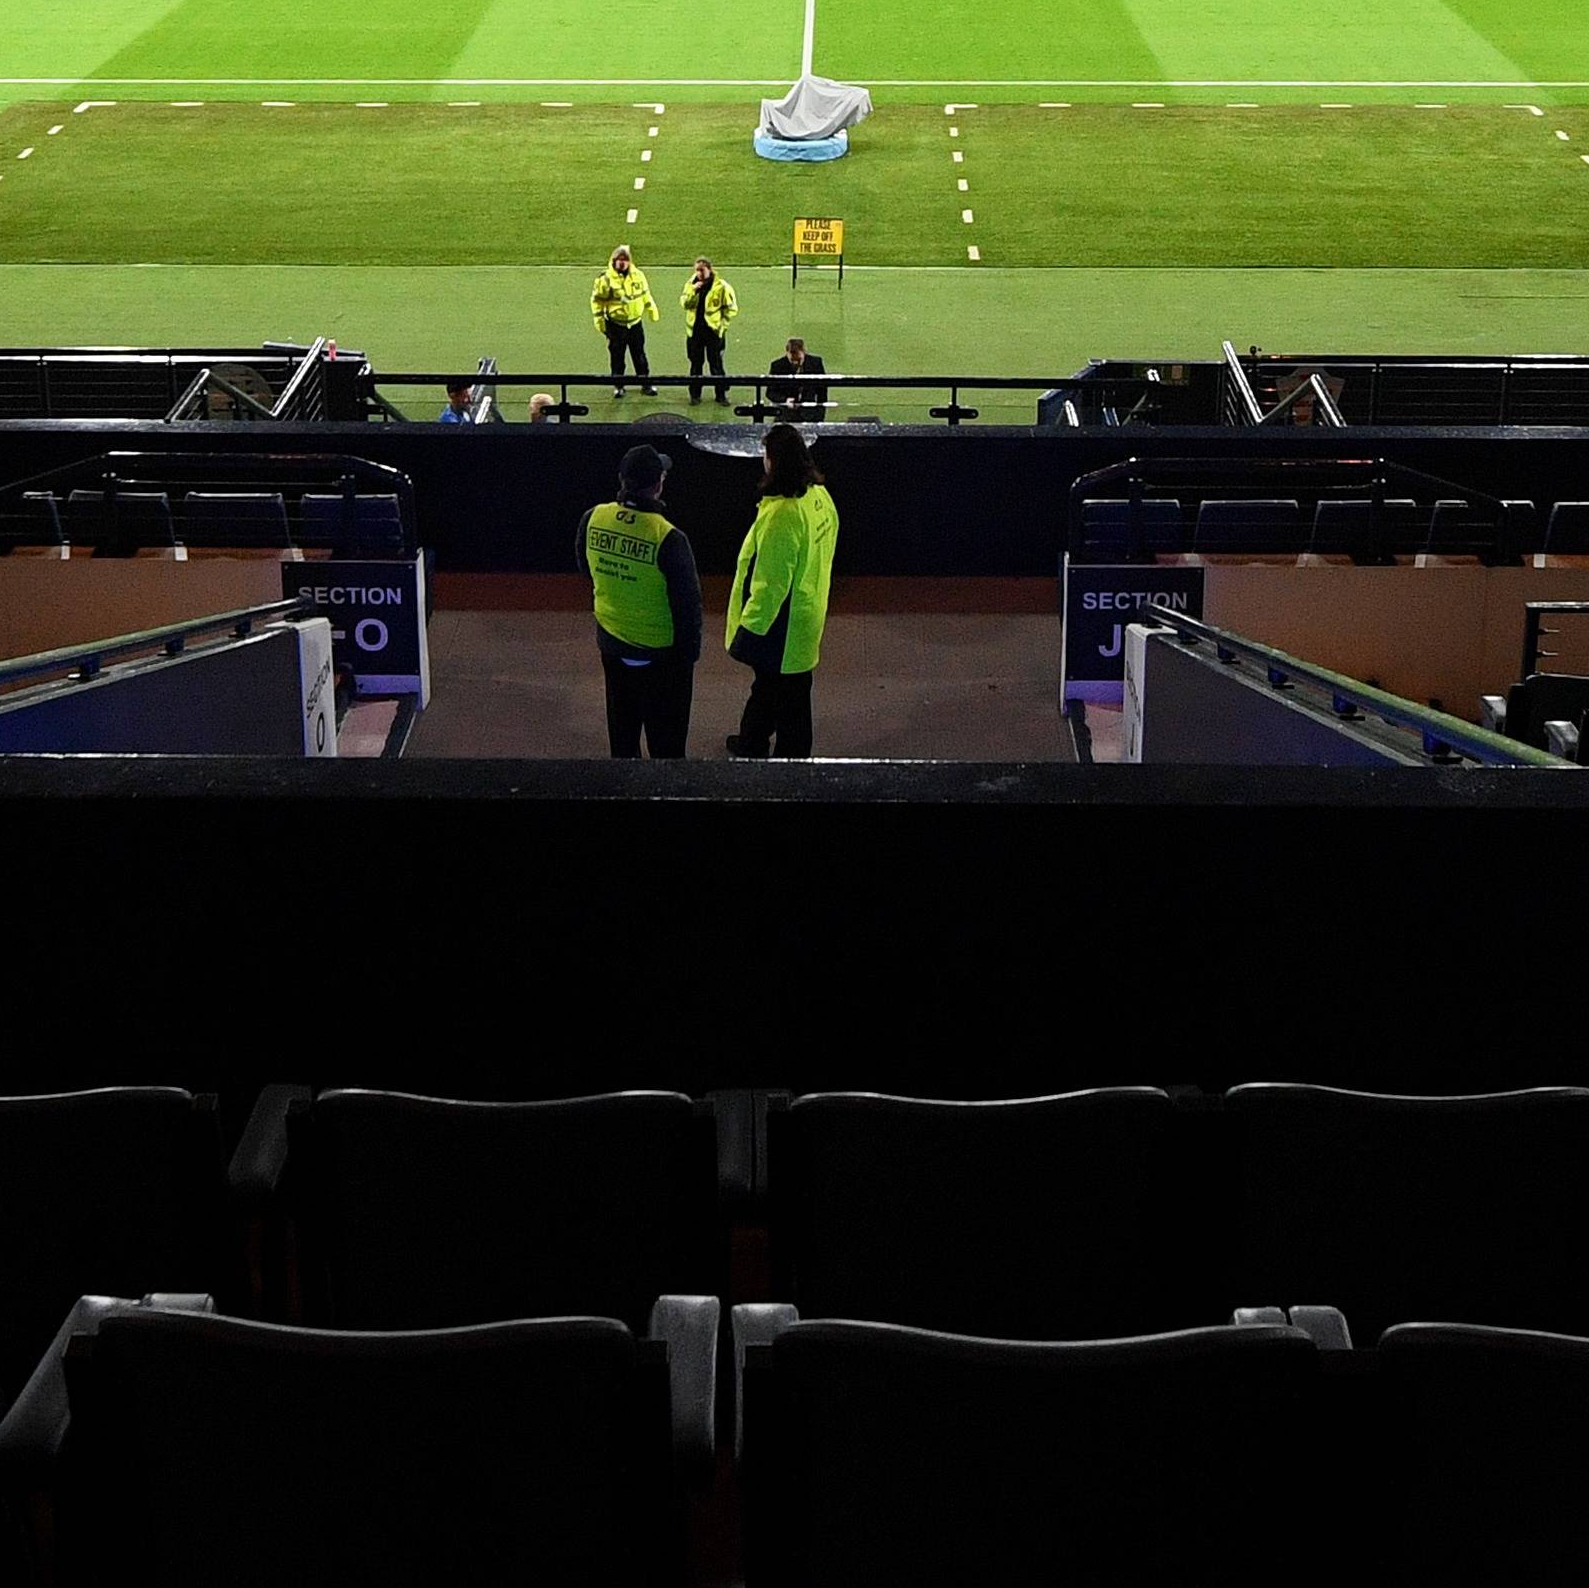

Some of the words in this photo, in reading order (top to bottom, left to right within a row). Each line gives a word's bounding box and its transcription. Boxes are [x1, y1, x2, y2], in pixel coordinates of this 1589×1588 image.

[802, 231, 820, 241] KEEP
[821, 231, 834, 241] OFF
[800, 242, 812, 253] THE
[814, 243, 837, 253] GRASS
[590, 531, 618, 551] EVENT
[620, 538, 651, 560] STAFF
[298, 586, 402, 605] SECTION
[1082, 591, 1187, 610] SECTION
[1098, 623, 1122, 657] J
